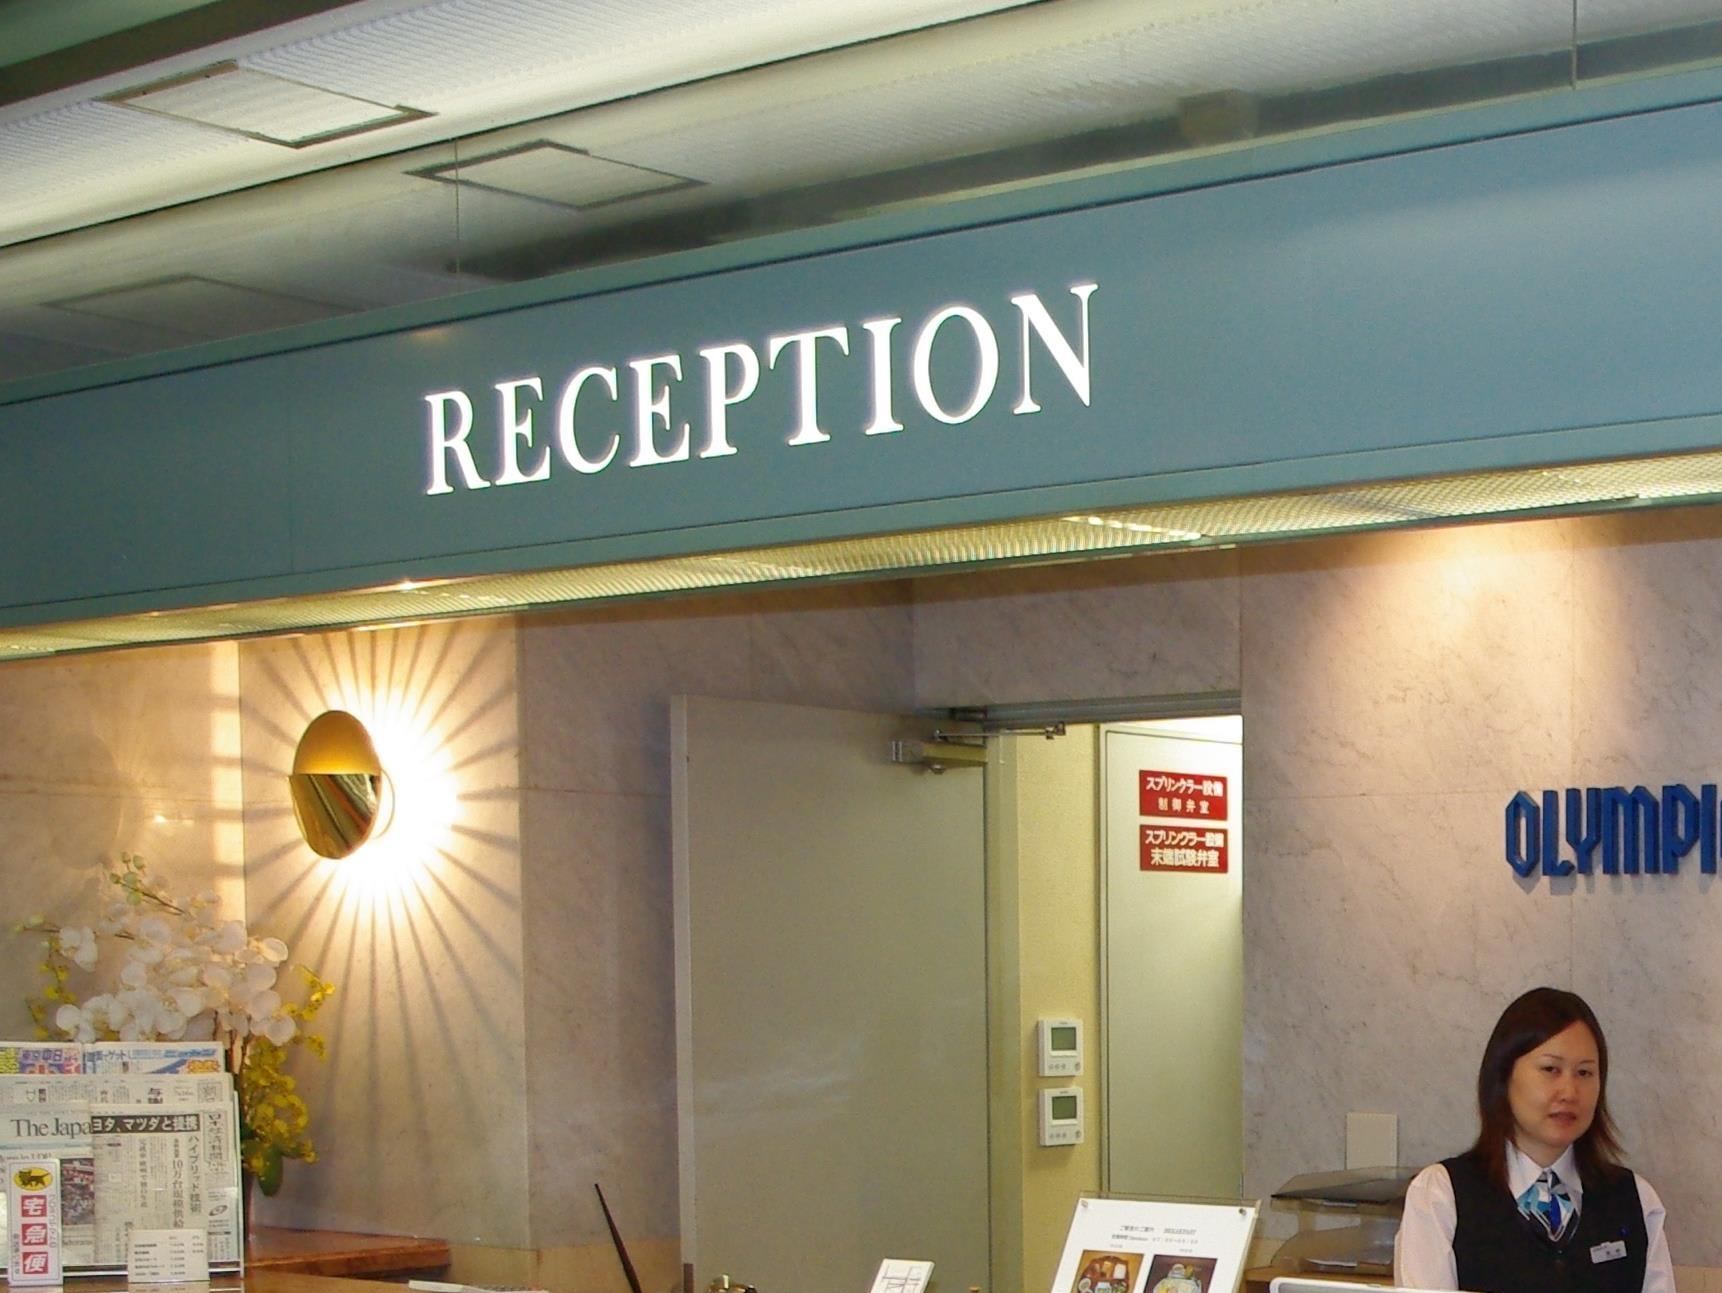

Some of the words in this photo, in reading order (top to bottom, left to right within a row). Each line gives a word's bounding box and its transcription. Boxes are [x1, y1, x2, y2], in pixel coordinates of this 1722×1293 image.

[425, 283, 1098, 496] RECEPTION
[10, 1118, 49, 1137] The
[22, 1197, 48, 1273] 宅急便
